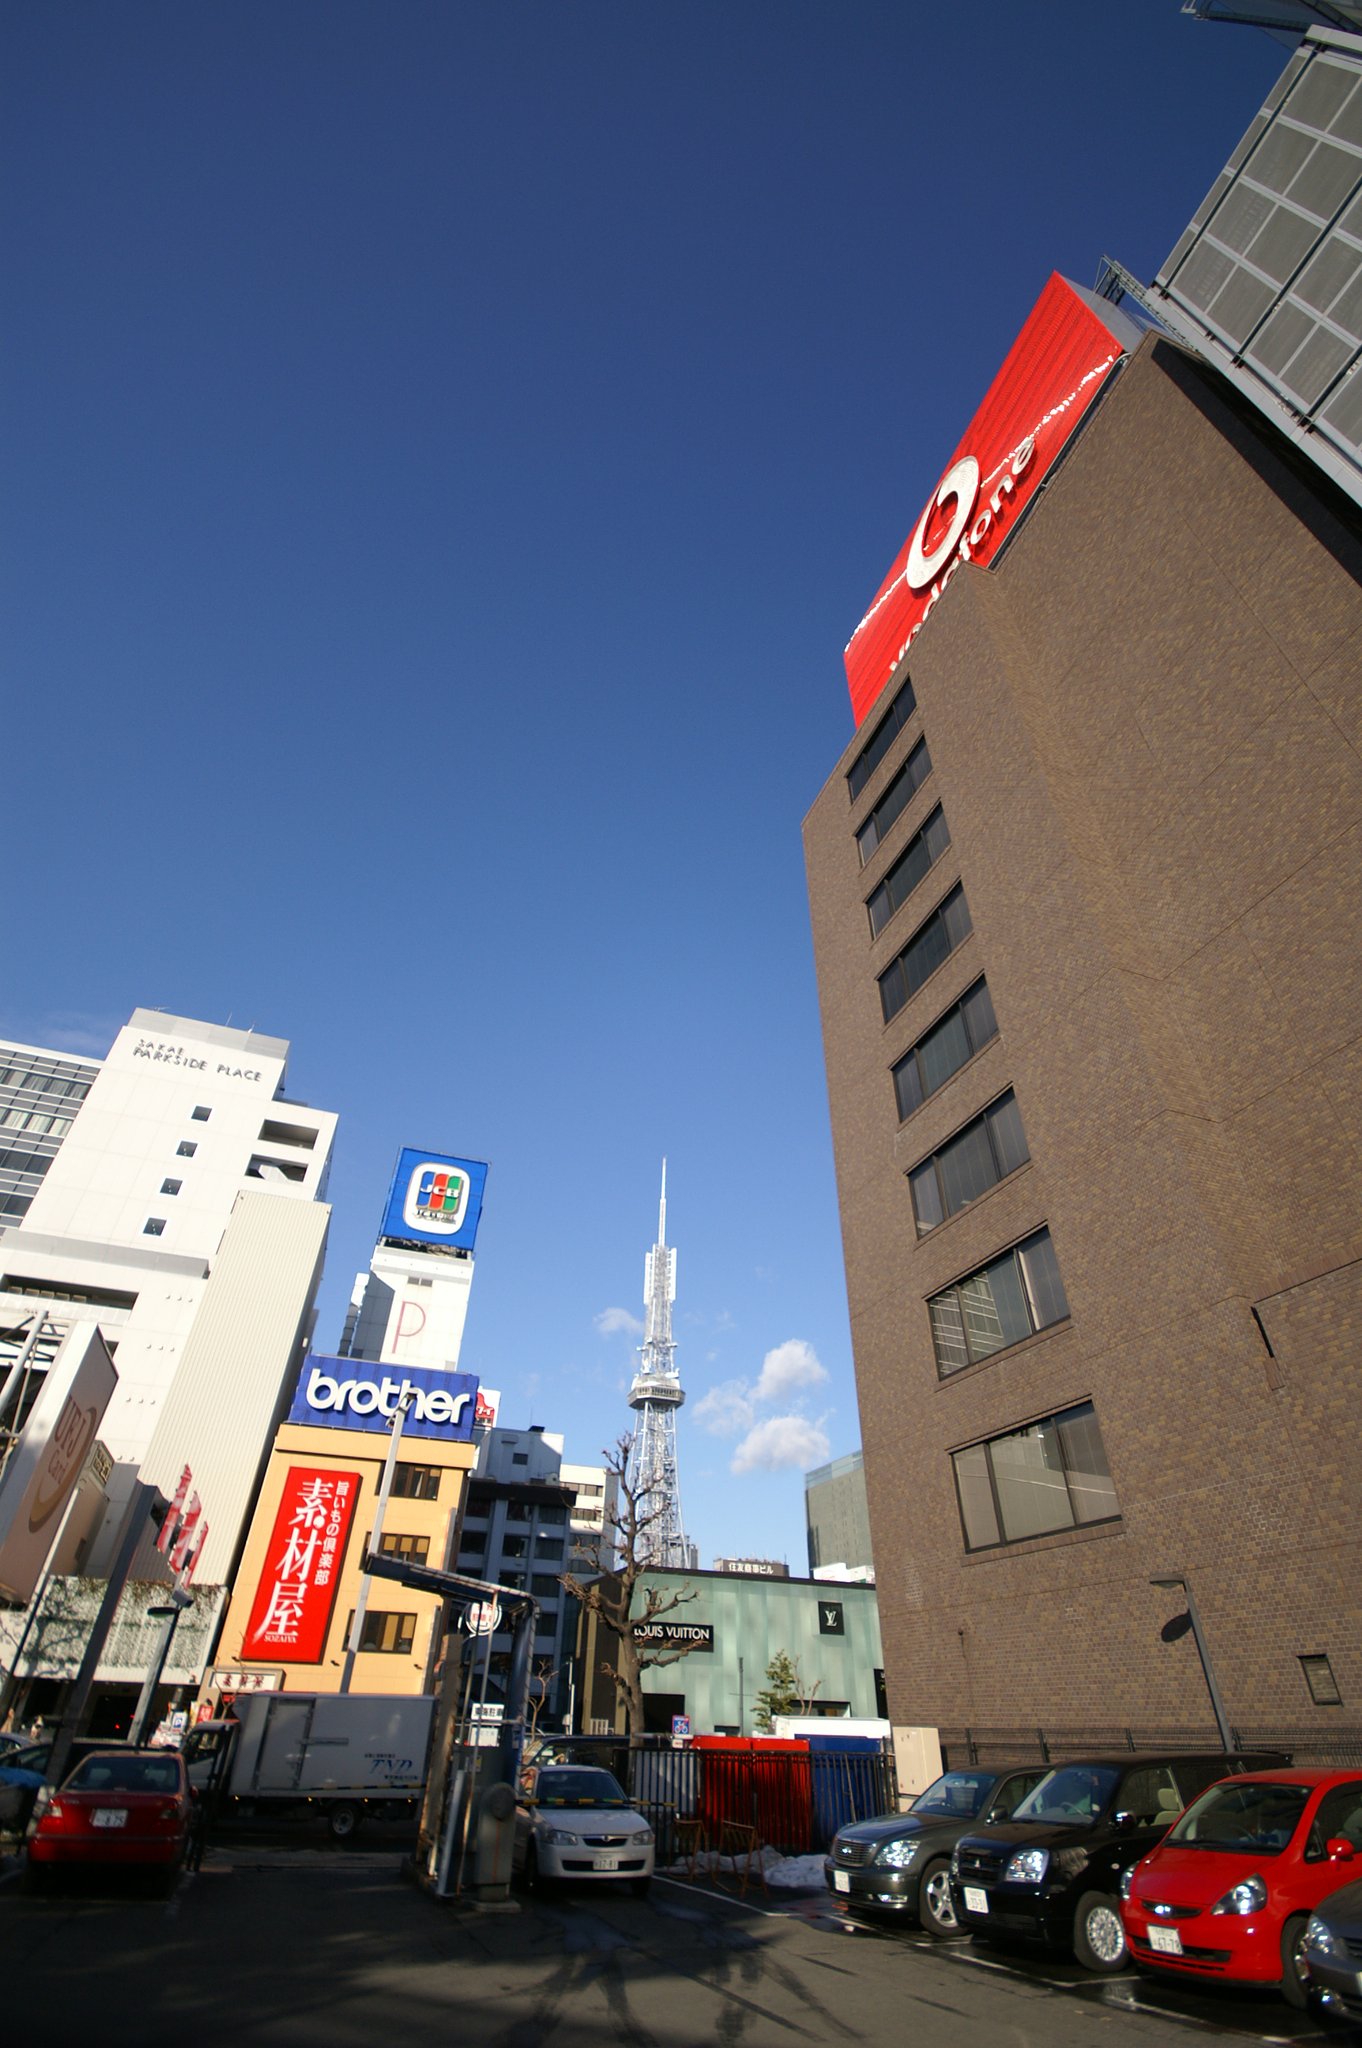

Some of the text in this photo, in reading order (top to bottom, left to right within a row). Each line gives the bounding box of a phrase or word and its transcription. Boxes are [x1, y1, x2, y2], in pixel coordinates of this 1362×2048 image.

[132, 1046, 262, 1082] PARKSIDE PLACE
[420, 1184, 460, 1199] JCB
[391, 1300, 427, 1354] P
[305, 1367, 471, 1425] brother
[54, 1394, 87, 1459] UFJ
[250, 1476, 335, 1645] 素材屋
[263, 1633, 297, 1644] SOZAIYA
[634, 1624, 710, 1639] LOUIS VUITTON
